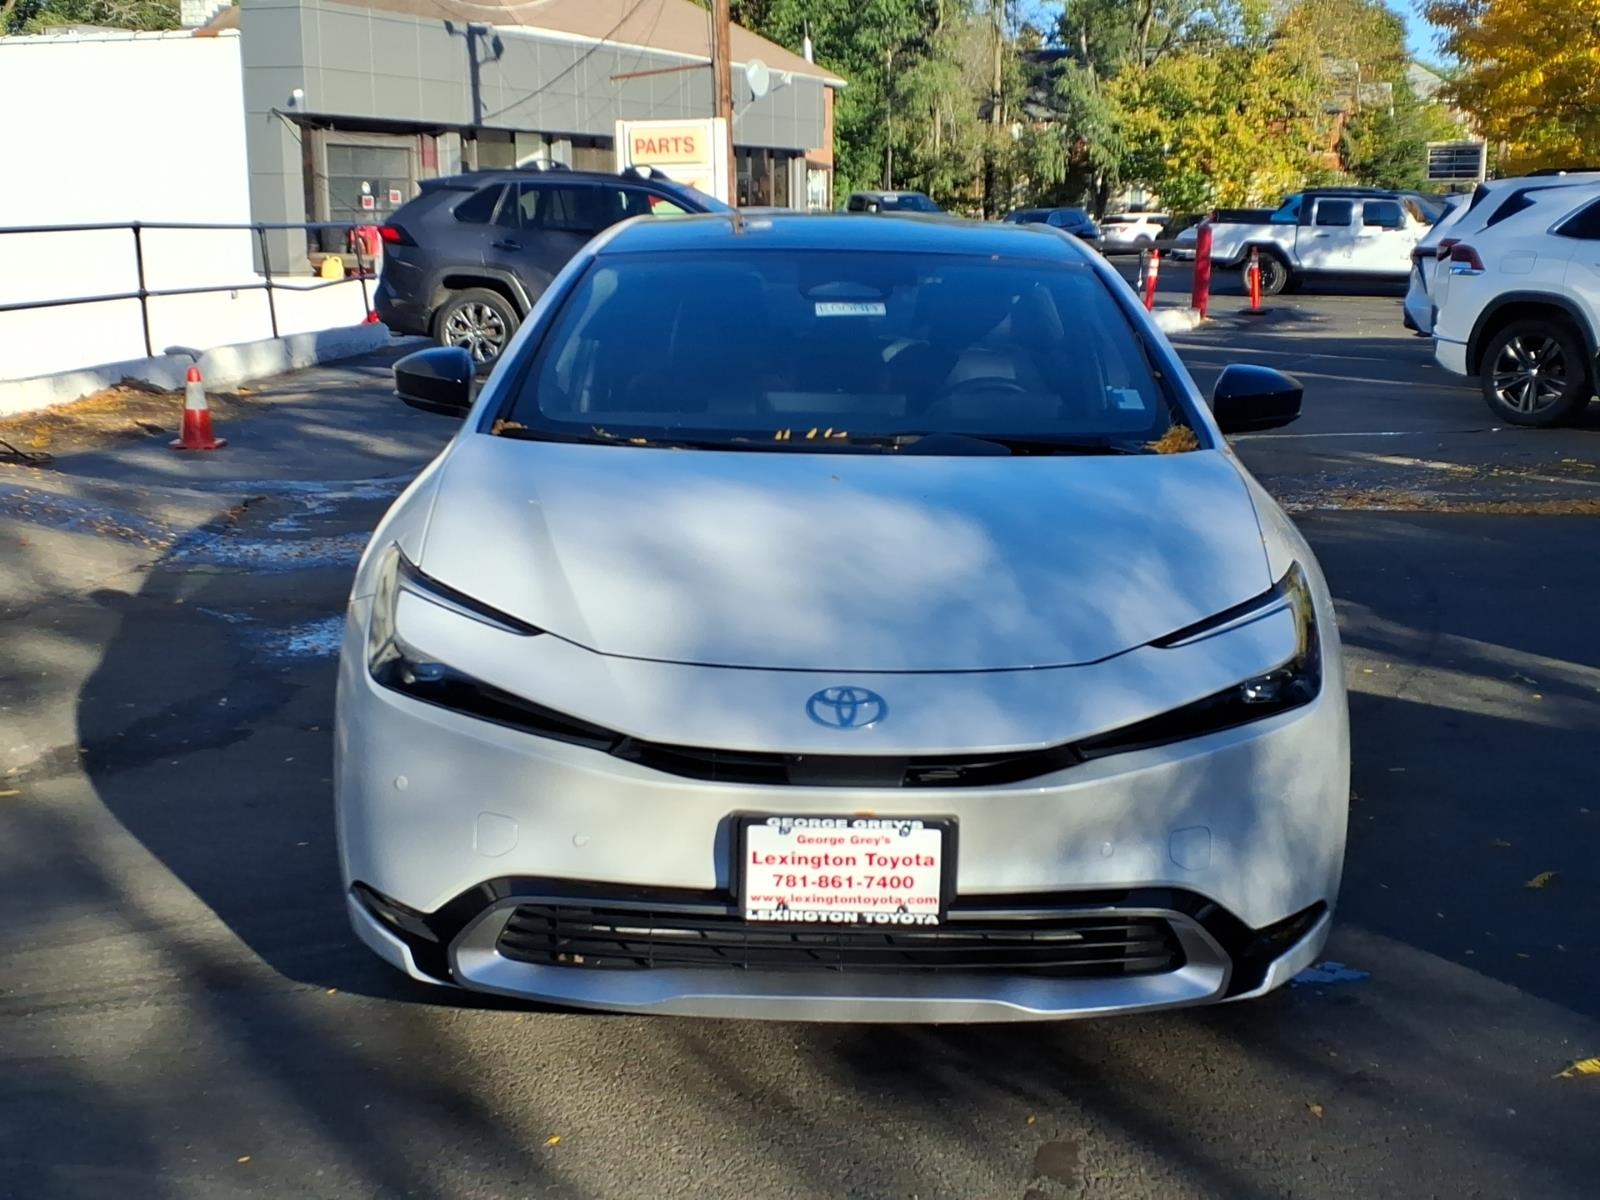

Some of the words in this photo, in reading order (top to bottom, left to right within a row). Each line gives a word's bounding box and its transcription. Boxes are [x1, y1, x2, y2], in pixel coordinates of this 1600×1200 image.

[635, 136, 695, 154] PARTS
[767, 818, 847, 829] GEORGE
[852, 819, 923, 830] GREY'S
[797, 835, 845, 846] George
[850, 835, 891, 846] Grey's
[752, 851, 857, 868] Lexington
[865, 853, 935, 869] Toyota
[773, 874, 914, 889] 781-861-7400
[750, 894, 938, 906] www.lexingtontoyota.com
[746, 910, 858, 923] LEXINGTON
[863, 912, 939, 925] TOYOTA
